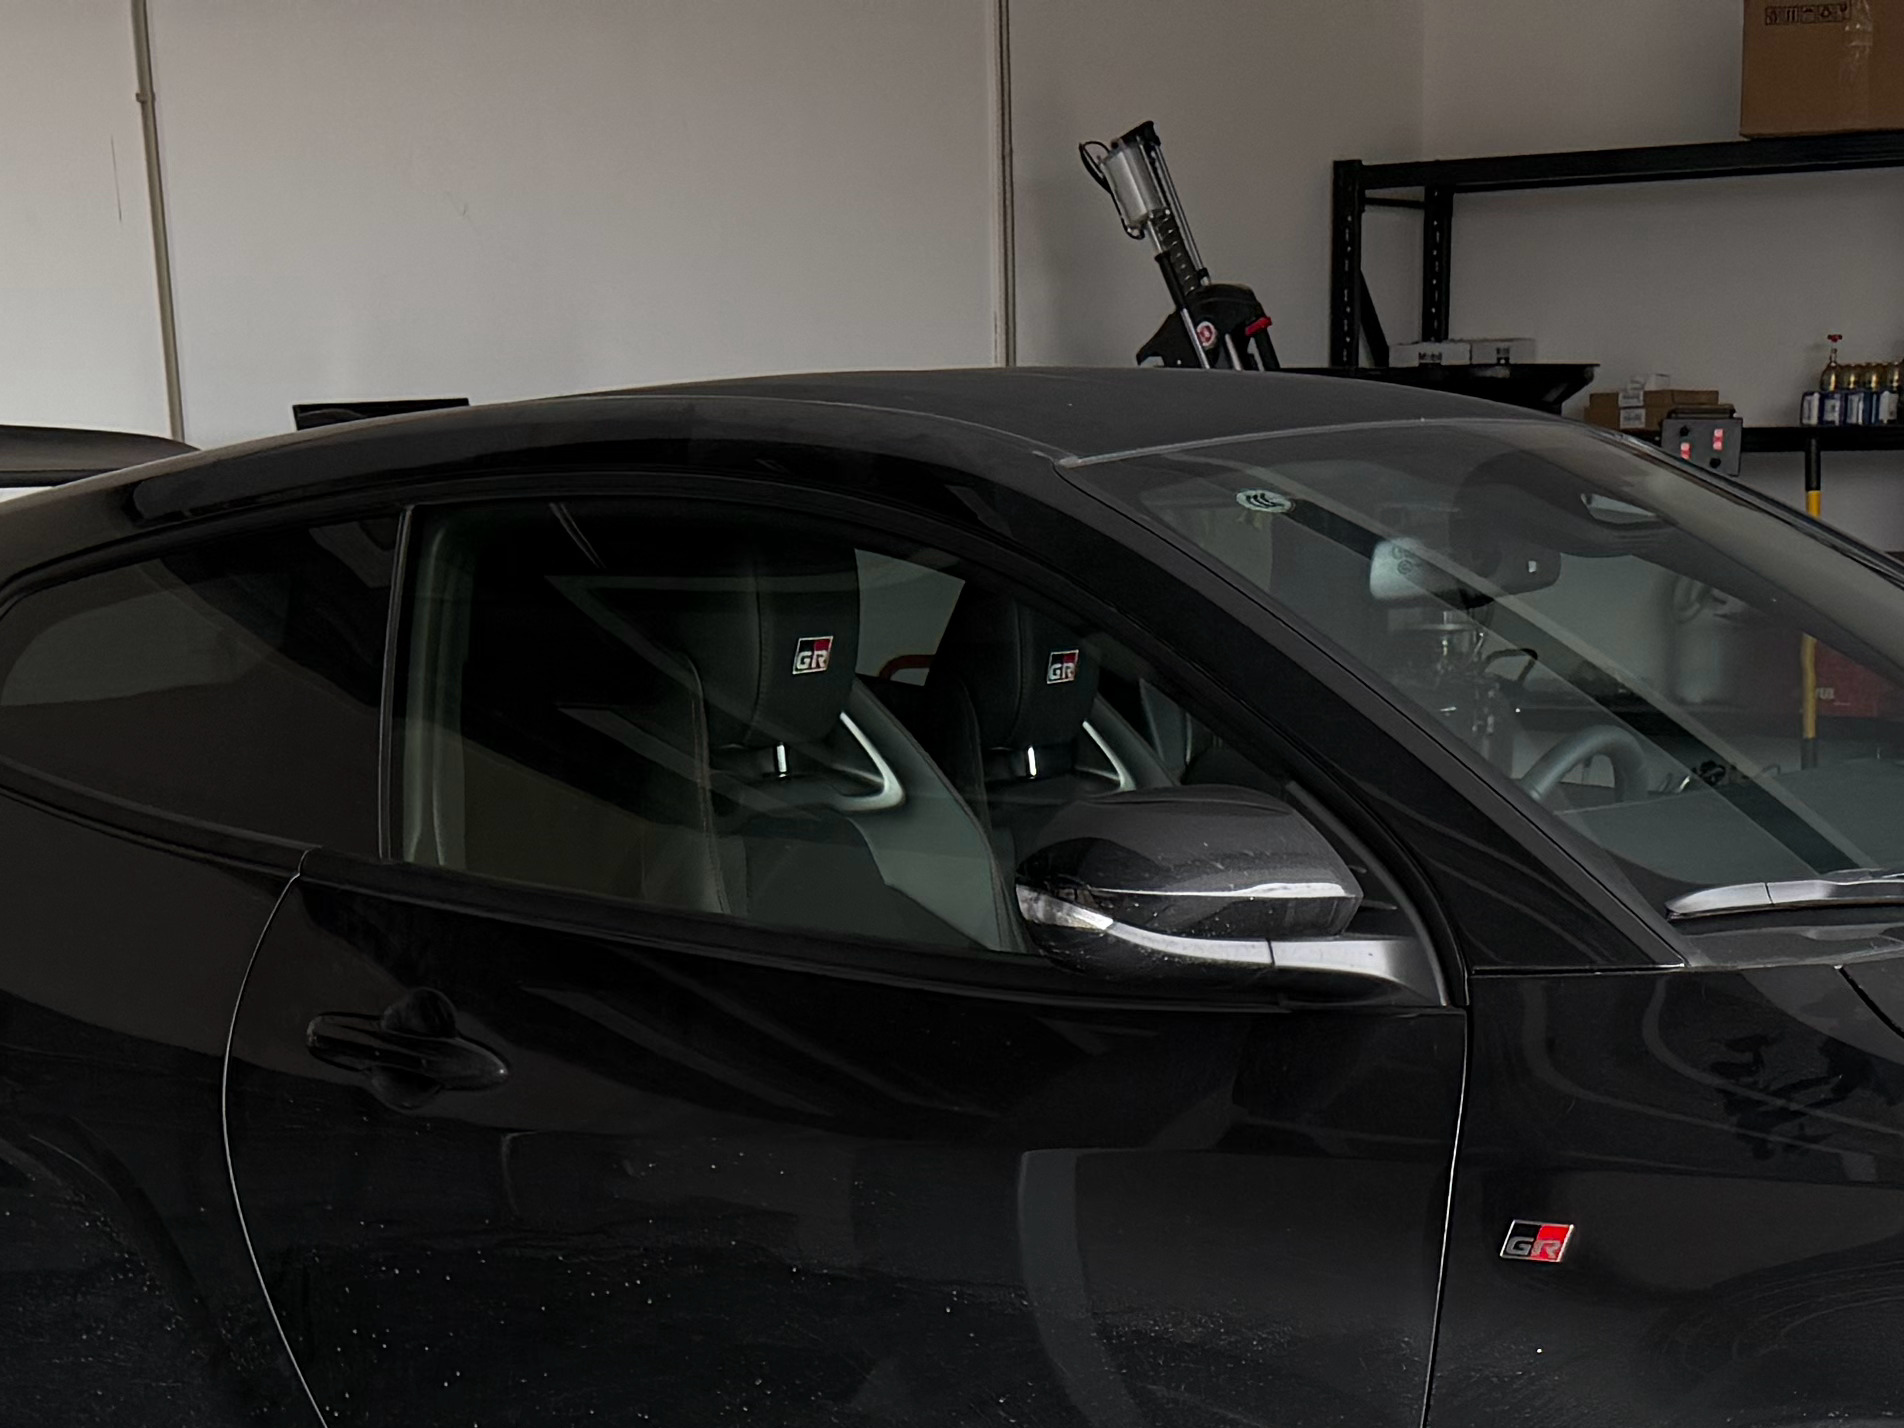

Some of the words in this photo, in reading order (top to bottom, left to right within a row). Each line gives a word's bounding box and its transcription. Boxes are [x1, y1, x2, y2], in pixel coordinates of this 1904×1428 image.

[796, 649, 828, 670] GR
[1048, 662, 1075, 682] GR
[1506, 1237, 1561, 1258] GR
